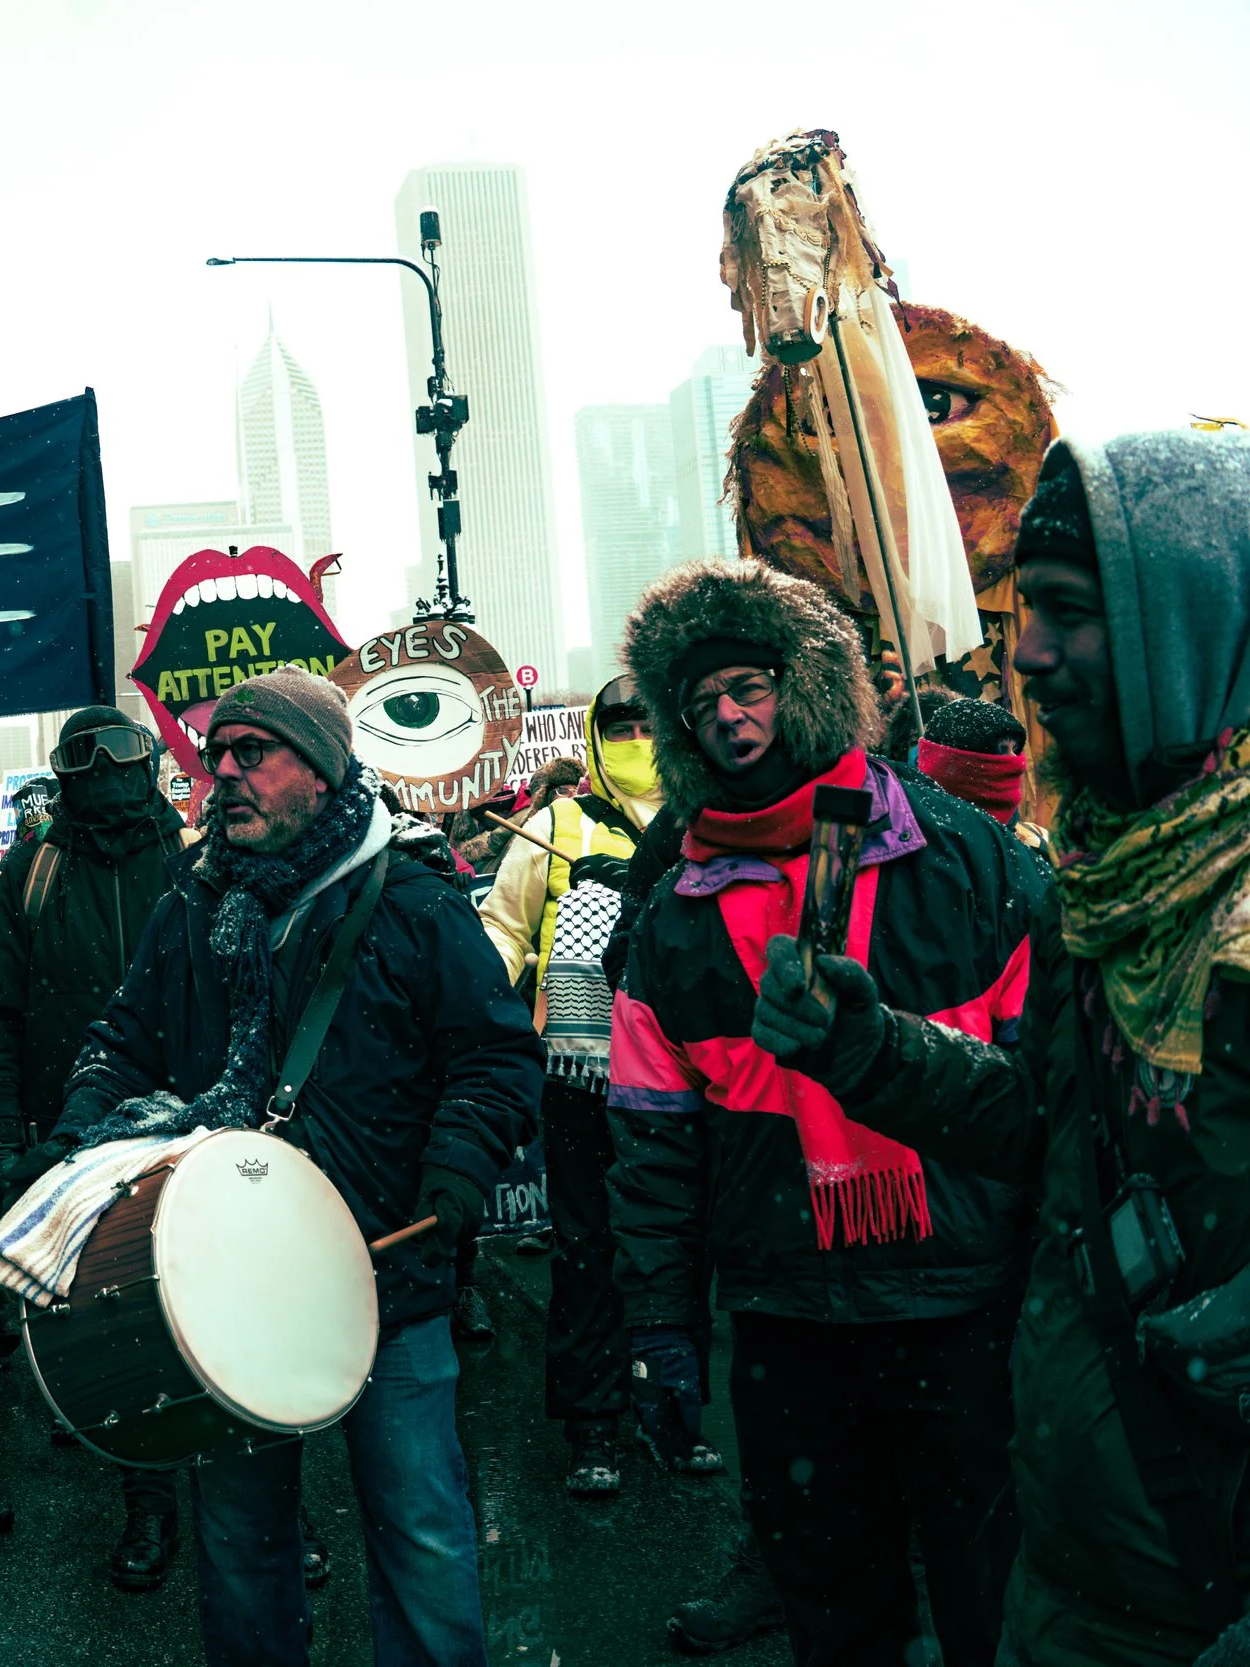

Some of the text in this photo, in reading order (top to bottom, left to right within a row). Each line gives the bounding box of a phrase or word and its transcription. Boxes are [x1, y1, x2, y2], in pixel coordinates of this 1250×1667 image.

[205, 622, 277, 662] PAY
[359, 623, 468, 674] EYES
[157, 655, 335, 702] ATTENTN
[521, 668, 535, 684] B
[479, 685, 521, 722] THE
[525, 713, 556, 743] WHO
[384, 731, 521, 811] MMUNITY
[510, 746, 562, 775] DERED
